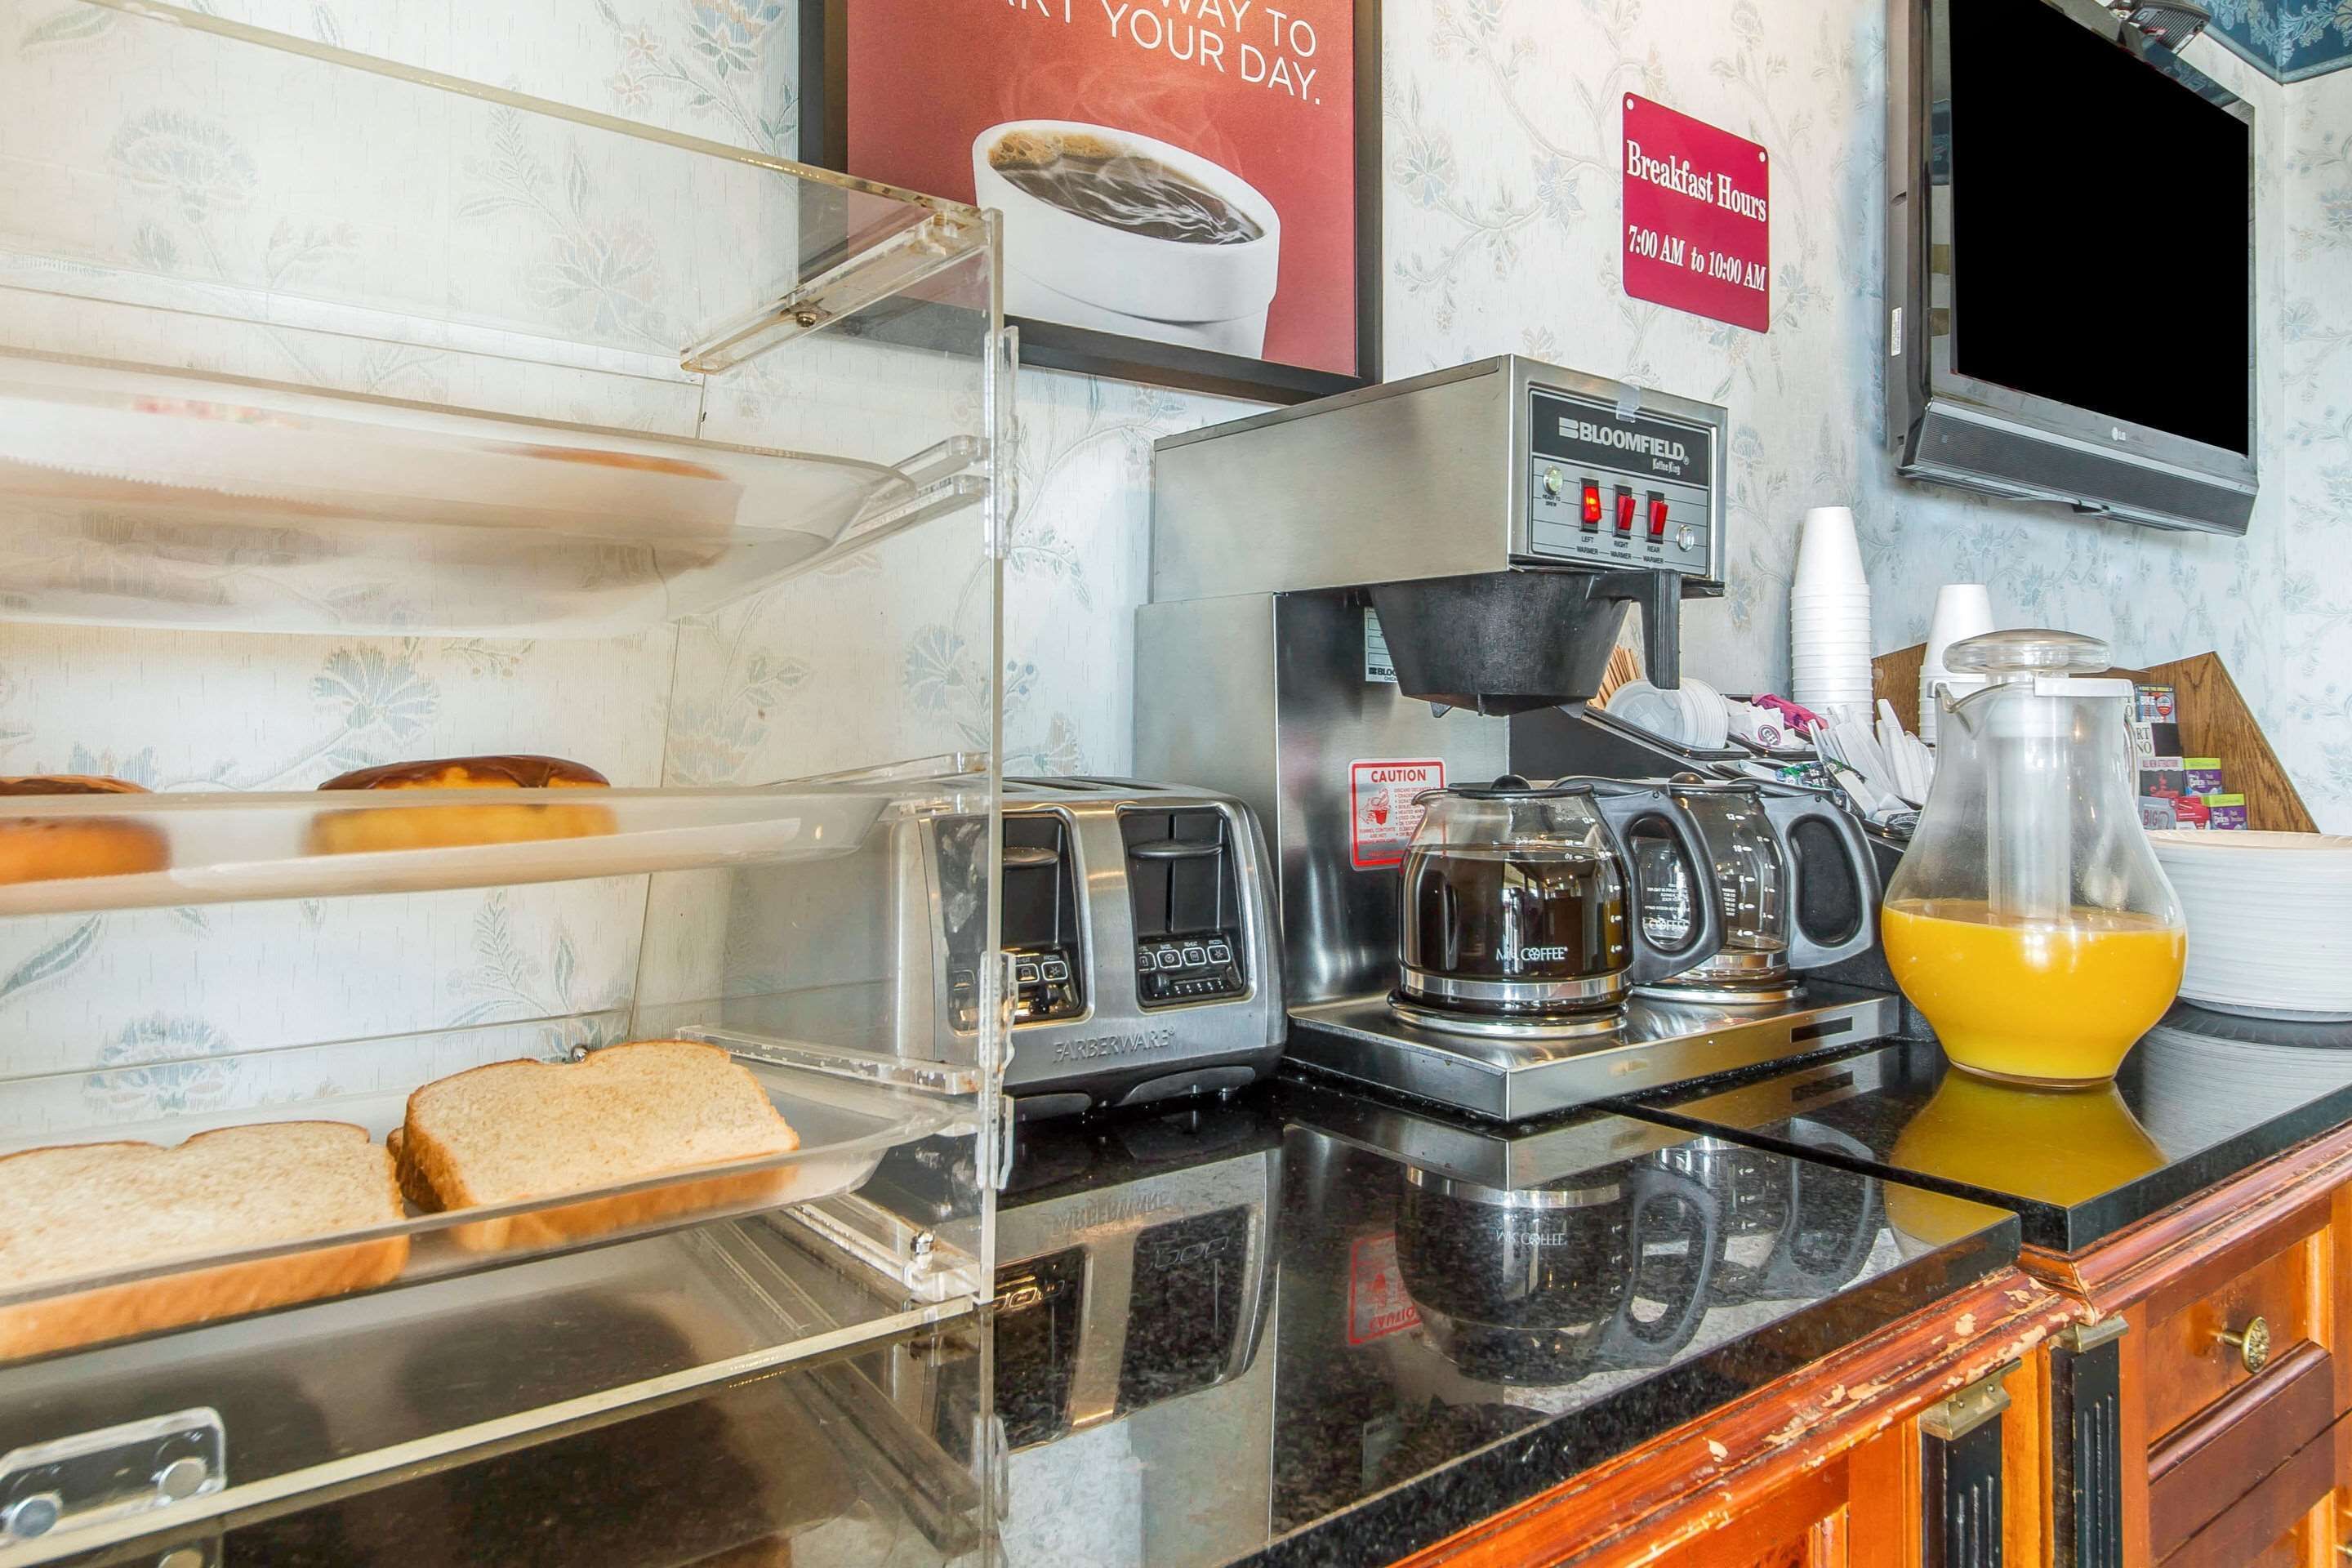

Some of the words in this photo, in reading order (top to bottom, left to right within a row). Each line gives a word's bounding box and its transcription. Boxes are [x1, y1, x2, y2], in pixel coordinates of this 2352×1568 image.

[1266, 7, 1316, 58] TO
[1102, 0, 1225, 73] YOUR
[1241, 43, 1321, 105] DAY.
[1627, 139, 1713, 203] Breakfast
[1717, 172, 1766, 222] Hours
[1628, 225, 1658, 259] 7:00
[1659, 234, 1686, 266] AM
[1690, 246, 1704, 273] to
[1708, 251, 1741, 284] 10:00
[1743, 261, 1766, 292] AM
[1579, 421, 1685, 461] BLOOMFIELD
[1581, 535, 1594, 543] LEFT
[1614, 540, 1628, 548] RIGHT
[1576, 546, 1599, 555] WARMER
[1610, 550, 1632, 560] WARMER
[1646, 545, 1660, 553] REAR
[1642, 555, 1664, 564] WARMER
[1370, 769, 1427, 783] CAUTION
[1521, 947, 1566, 961] COFFEE
[1053, 1029, 1169, 1062] FARBERWARE
